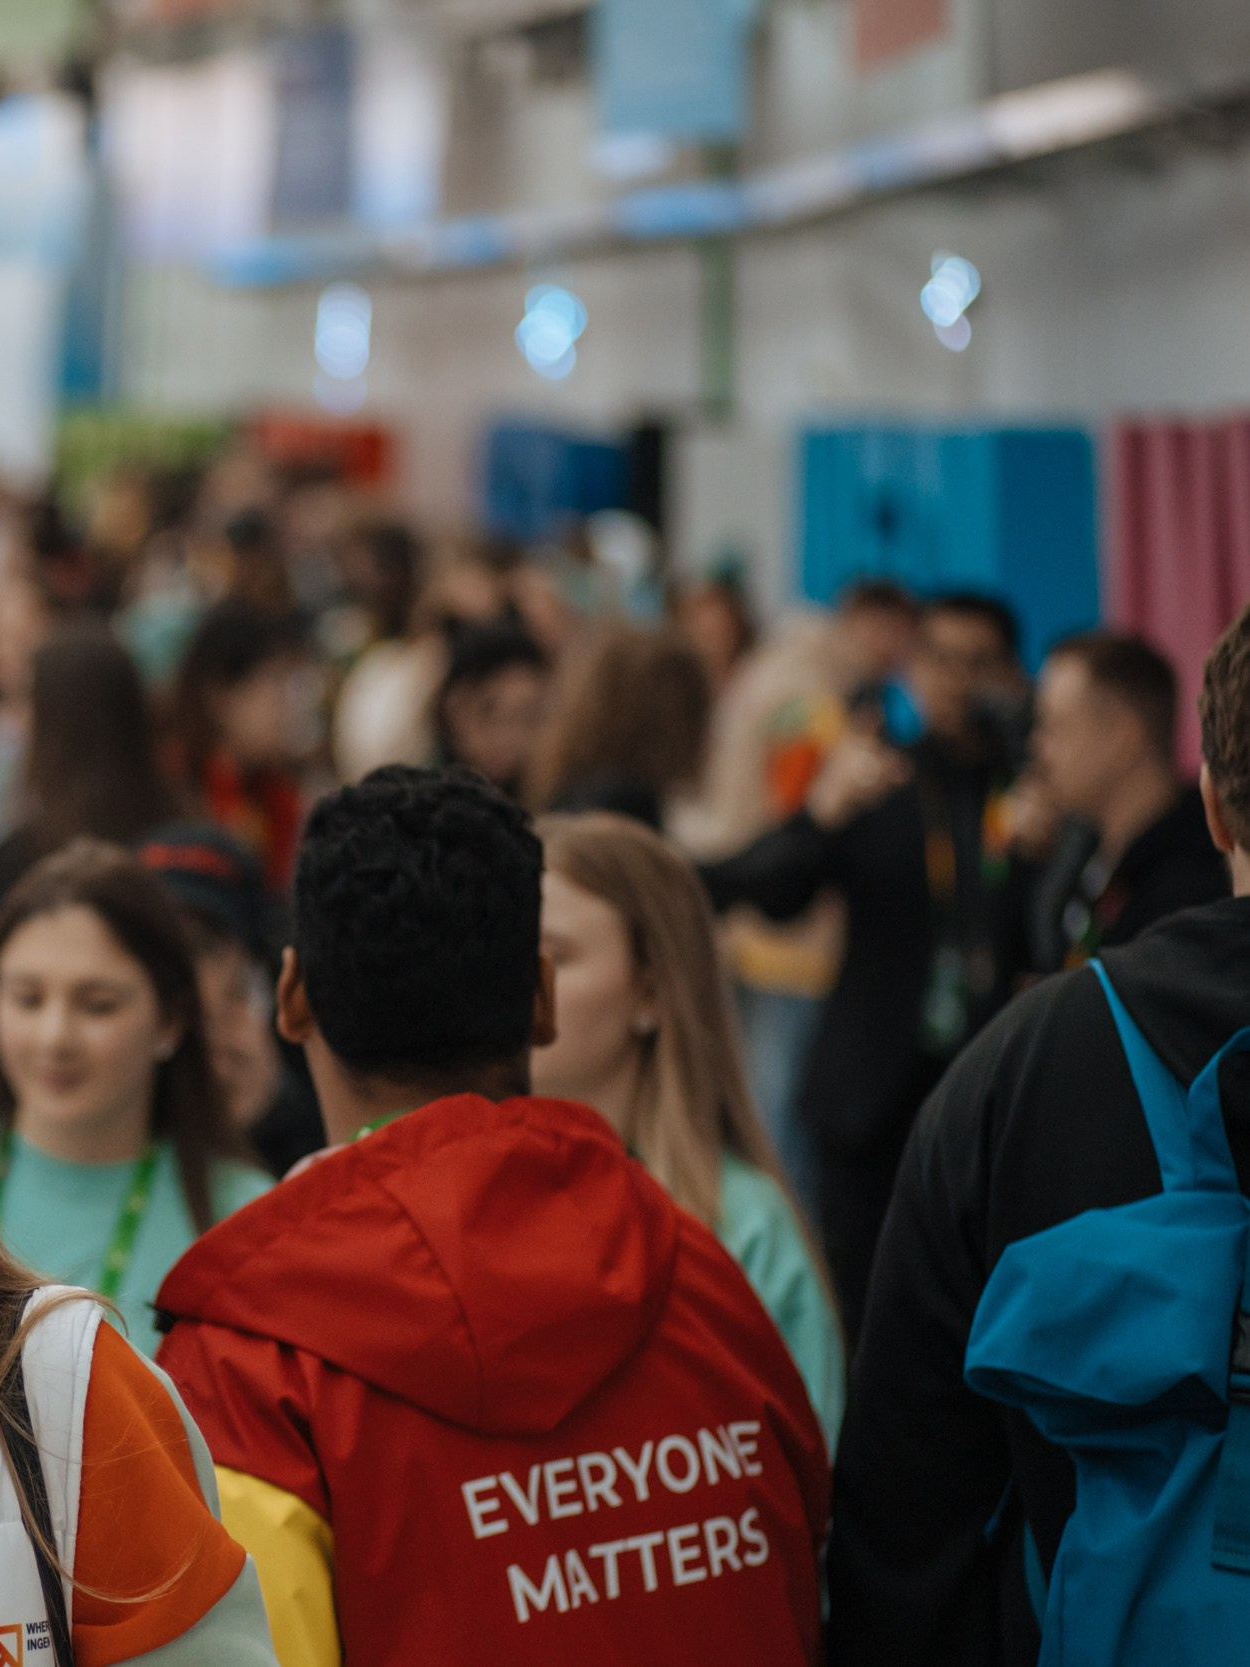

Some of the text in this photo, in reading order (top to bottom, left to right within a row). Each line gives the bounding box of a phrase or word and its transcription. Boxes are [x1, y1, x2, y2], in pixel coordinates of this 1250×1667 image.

[461, 1420, 763, 1539] EVERYONE
[506, 1507, 769, 1623] MATTERS
[26, 1620, 50, 1635] WHER
